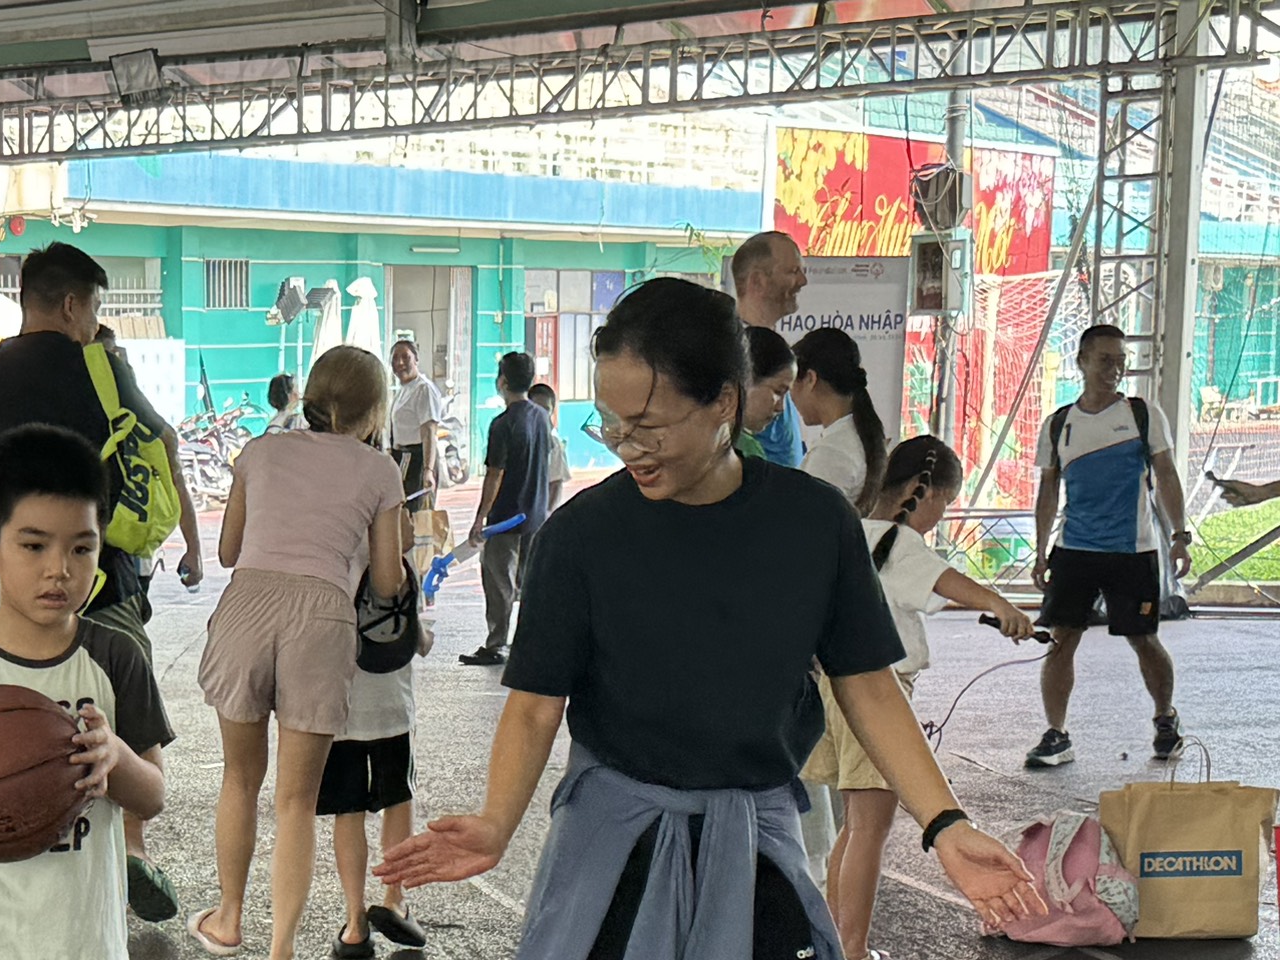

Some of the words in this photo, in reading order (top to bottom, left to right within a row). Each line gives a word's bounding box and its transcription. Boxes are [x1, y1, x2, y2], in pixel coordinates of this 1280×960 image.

[781, 315, 816, 332] HAO
[859, 309, 904, 334] NHẬP
[1065, 423, 1072, 447] 1
[1143, 855, 1237, 873] DECATHLON
